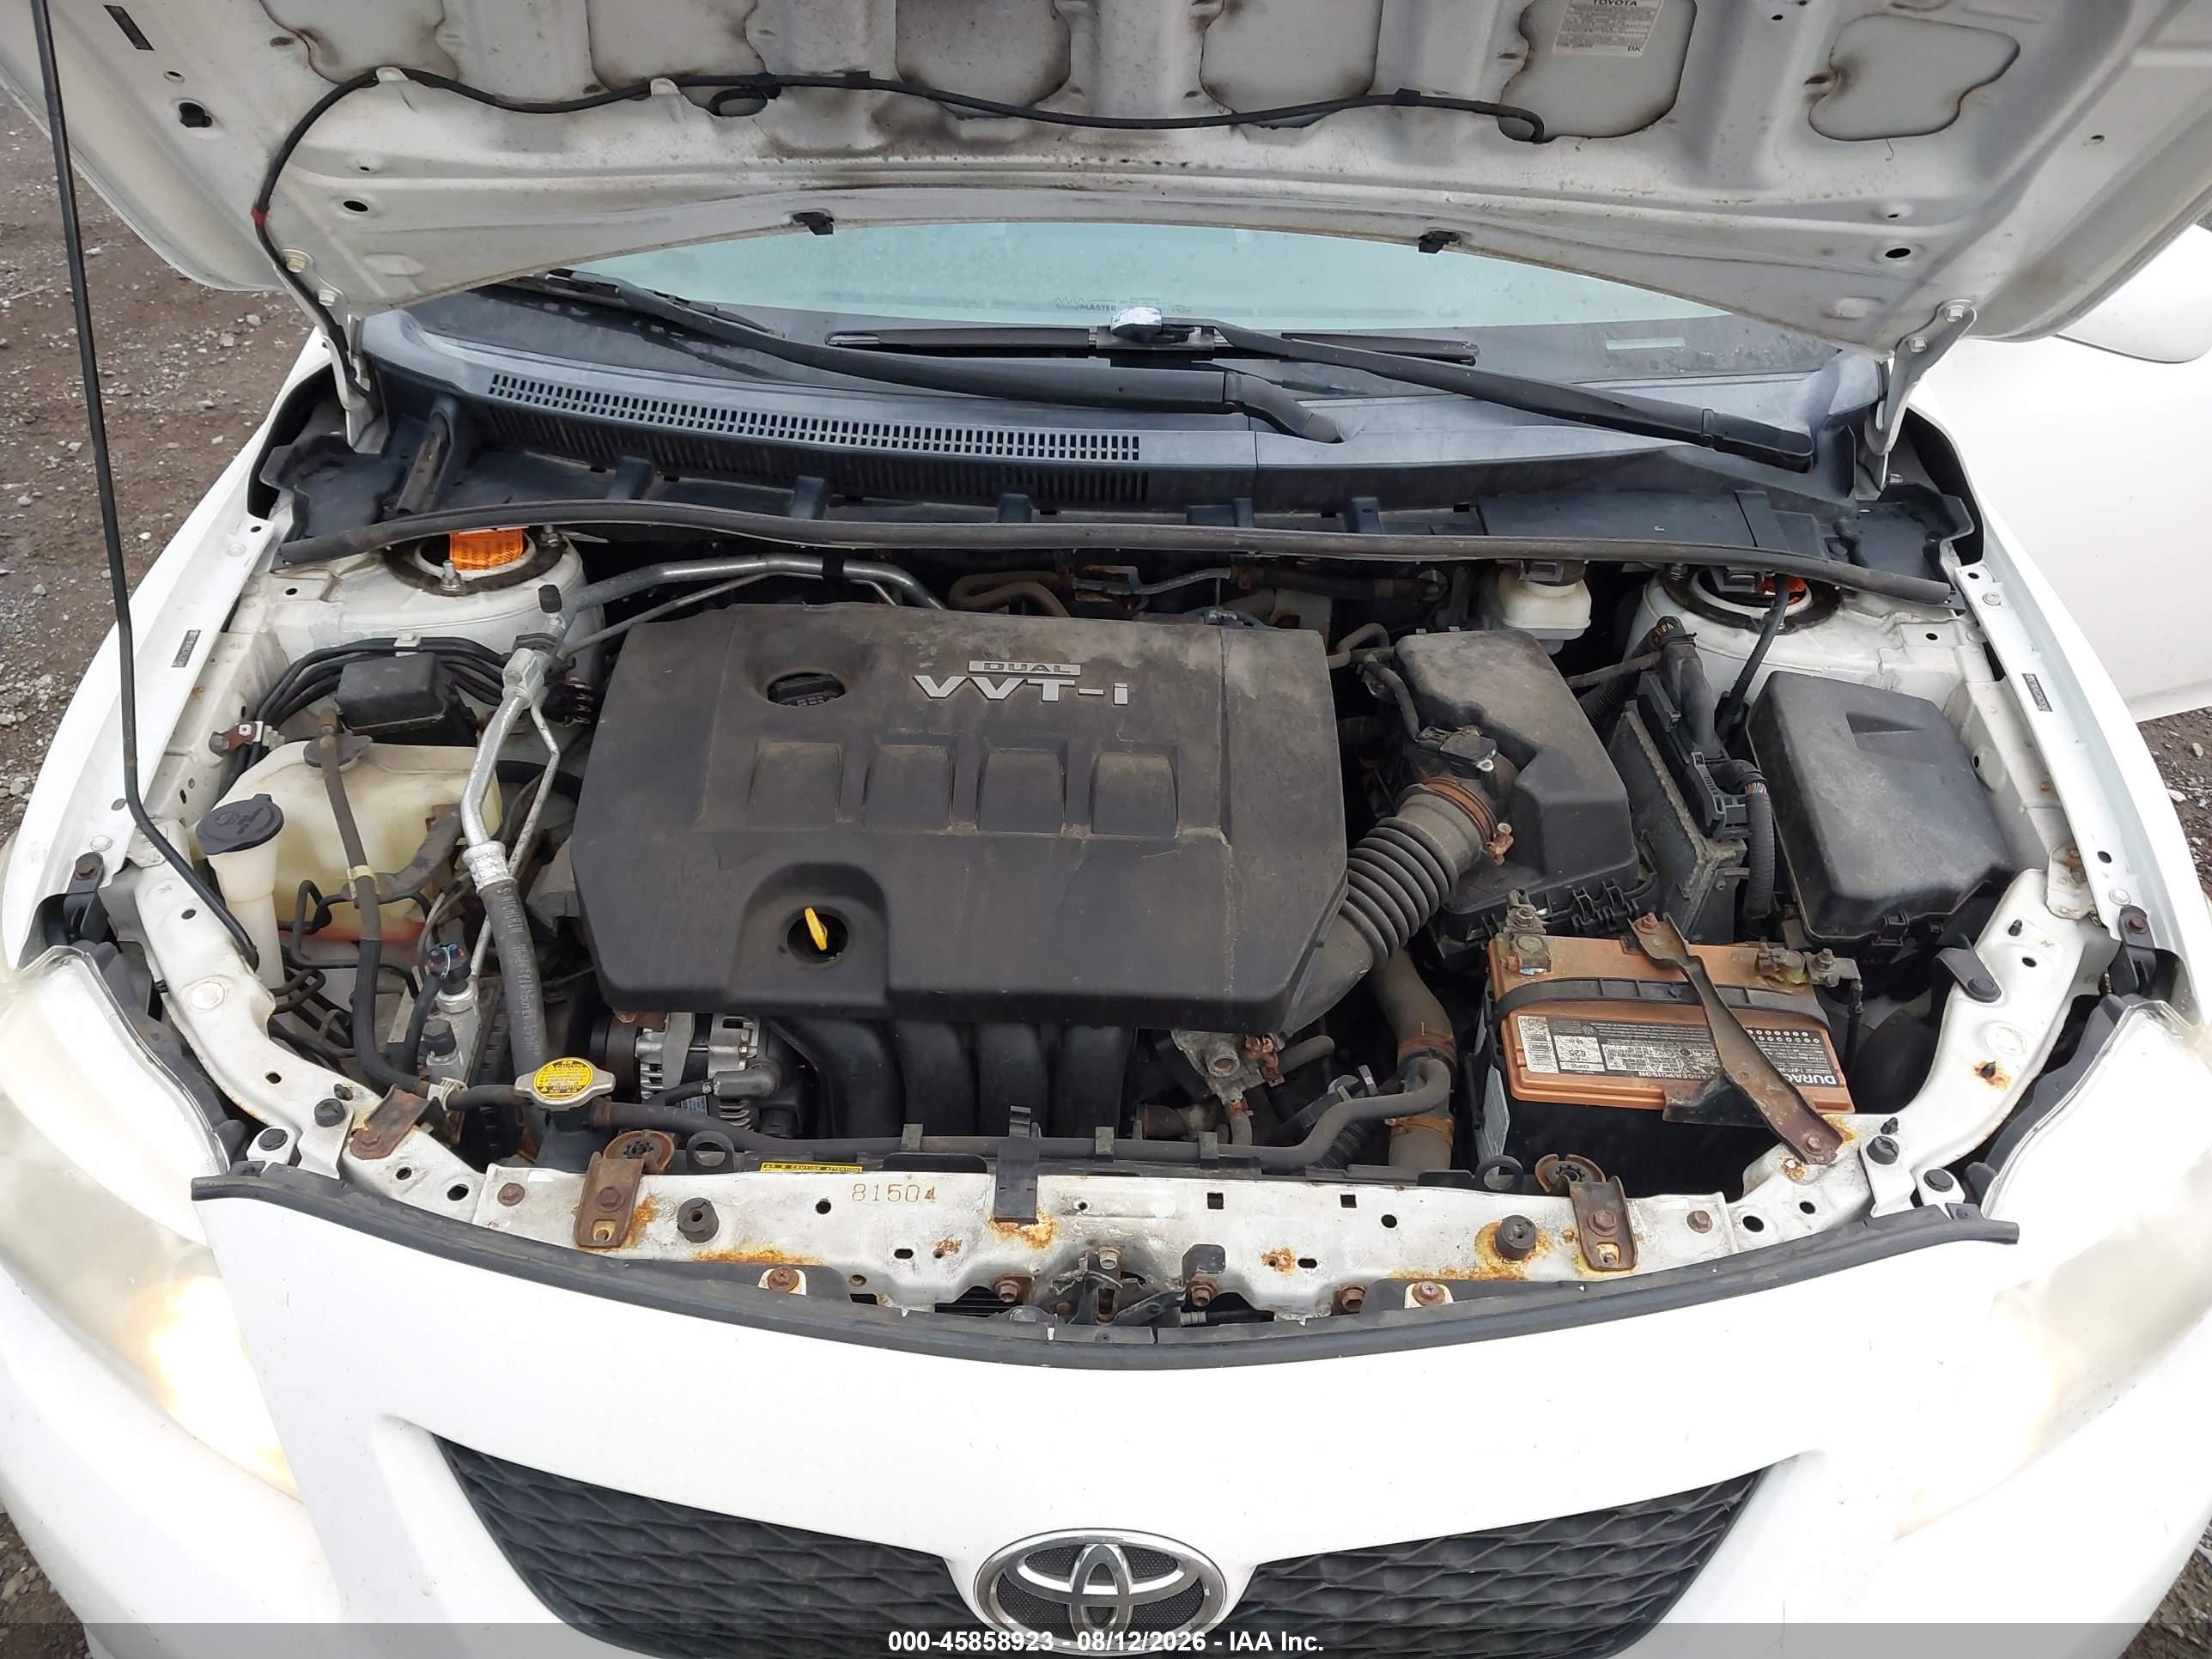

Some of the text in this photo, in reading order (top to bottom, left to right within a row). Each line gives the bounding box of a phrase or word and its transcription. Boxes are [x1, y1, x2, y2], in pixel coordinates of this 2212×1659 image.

[984, 662, 1072, 673] DUAL
[912, 675, 1128, 705] VVT-i
[1568, 1049, 1587, 1058] 625
[852, 1183, 937, 1202] 81504
